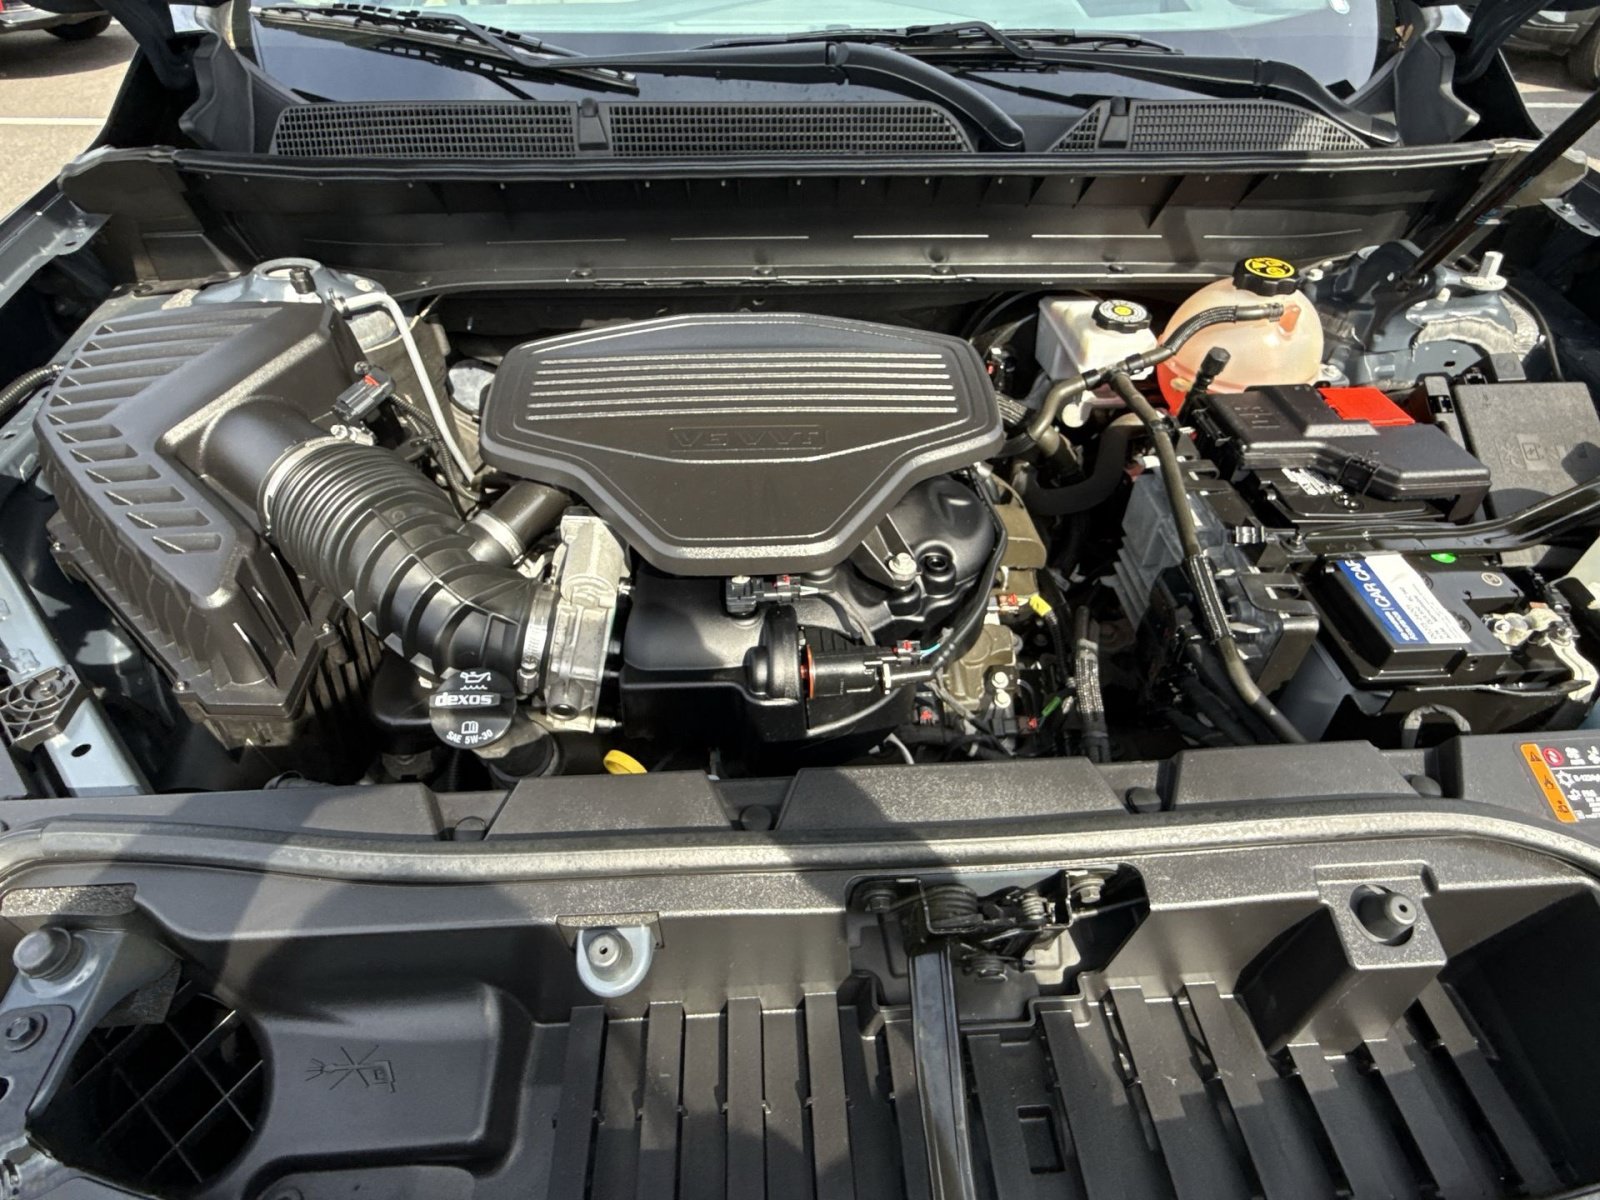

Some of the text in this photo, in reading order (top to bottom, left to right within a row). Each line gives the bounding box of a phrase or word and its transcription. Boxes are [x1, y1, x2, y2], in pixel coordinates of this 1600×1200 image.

[1363, 583, 1390, 607] CAR
[435, 692, 494, 707] dexos
[447, 730, 493, 744] SAE 5W-30
